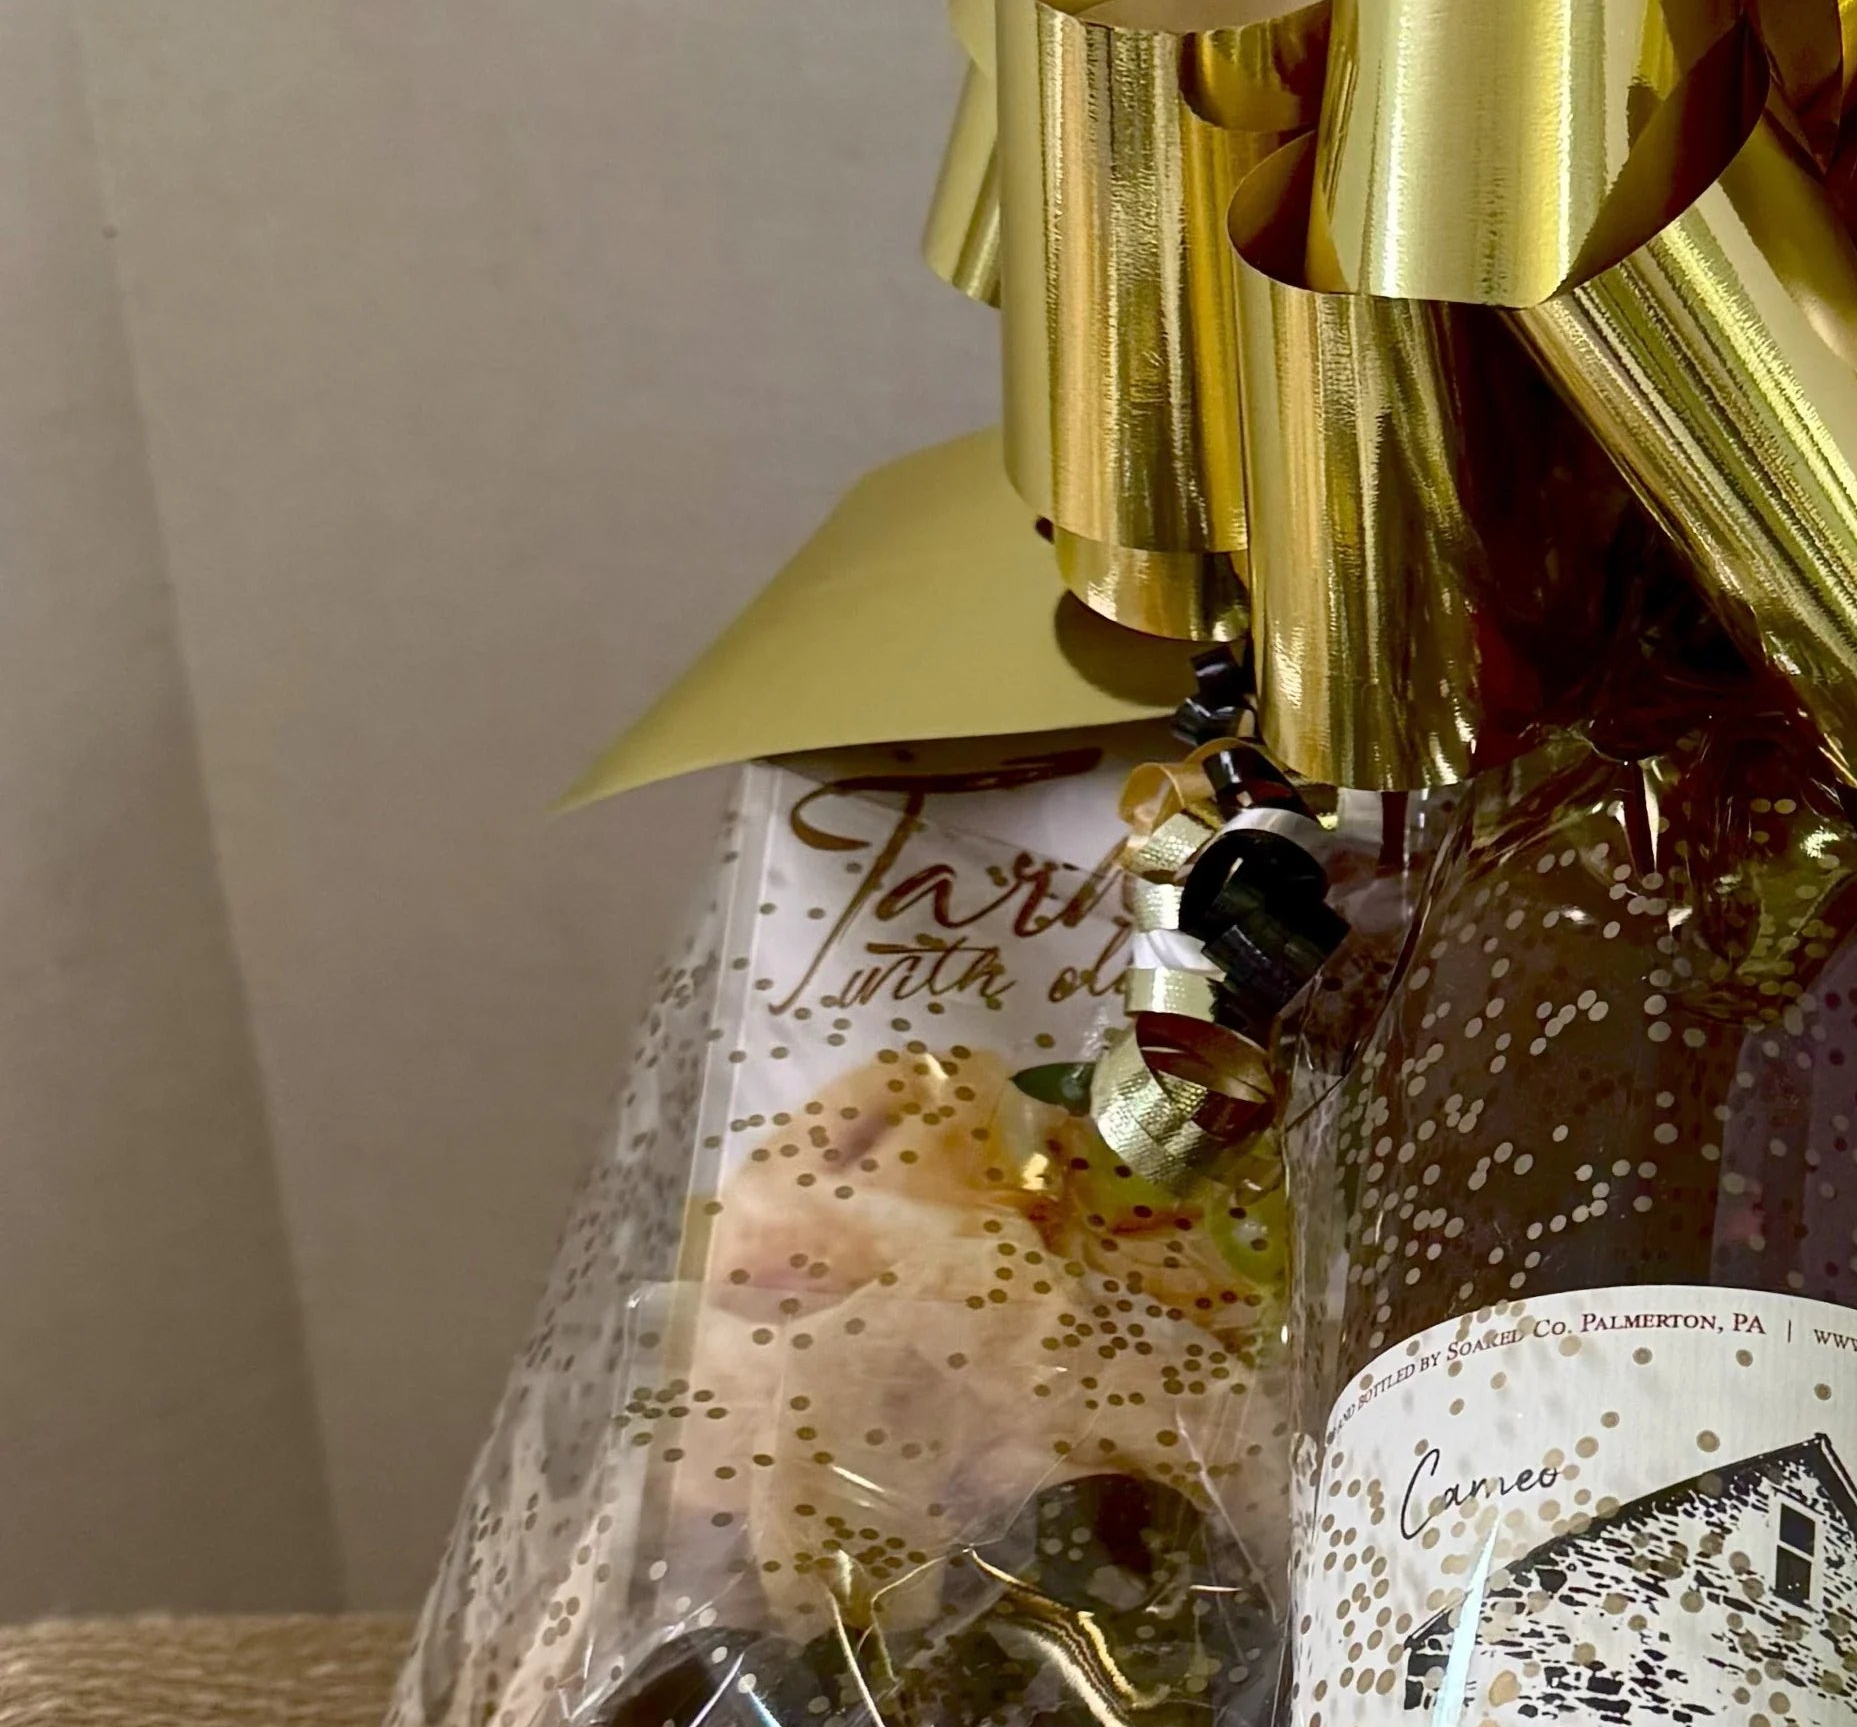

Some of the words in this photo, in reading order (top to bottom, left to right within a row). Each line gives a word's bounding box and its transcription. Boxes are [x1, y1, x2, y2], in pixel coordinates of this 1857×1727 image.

[840, 936, 1017, 1008] with
[1357, 1363, 1416, 1411] BOTTLED
[1419, 1351, 1441, 1373] BY
[1580, 1312, 1724, 1335] PALMERTON,
[1731, 1312, 1767, 1335] PA
[1400, 1448, 1561, 1540] Cameo
